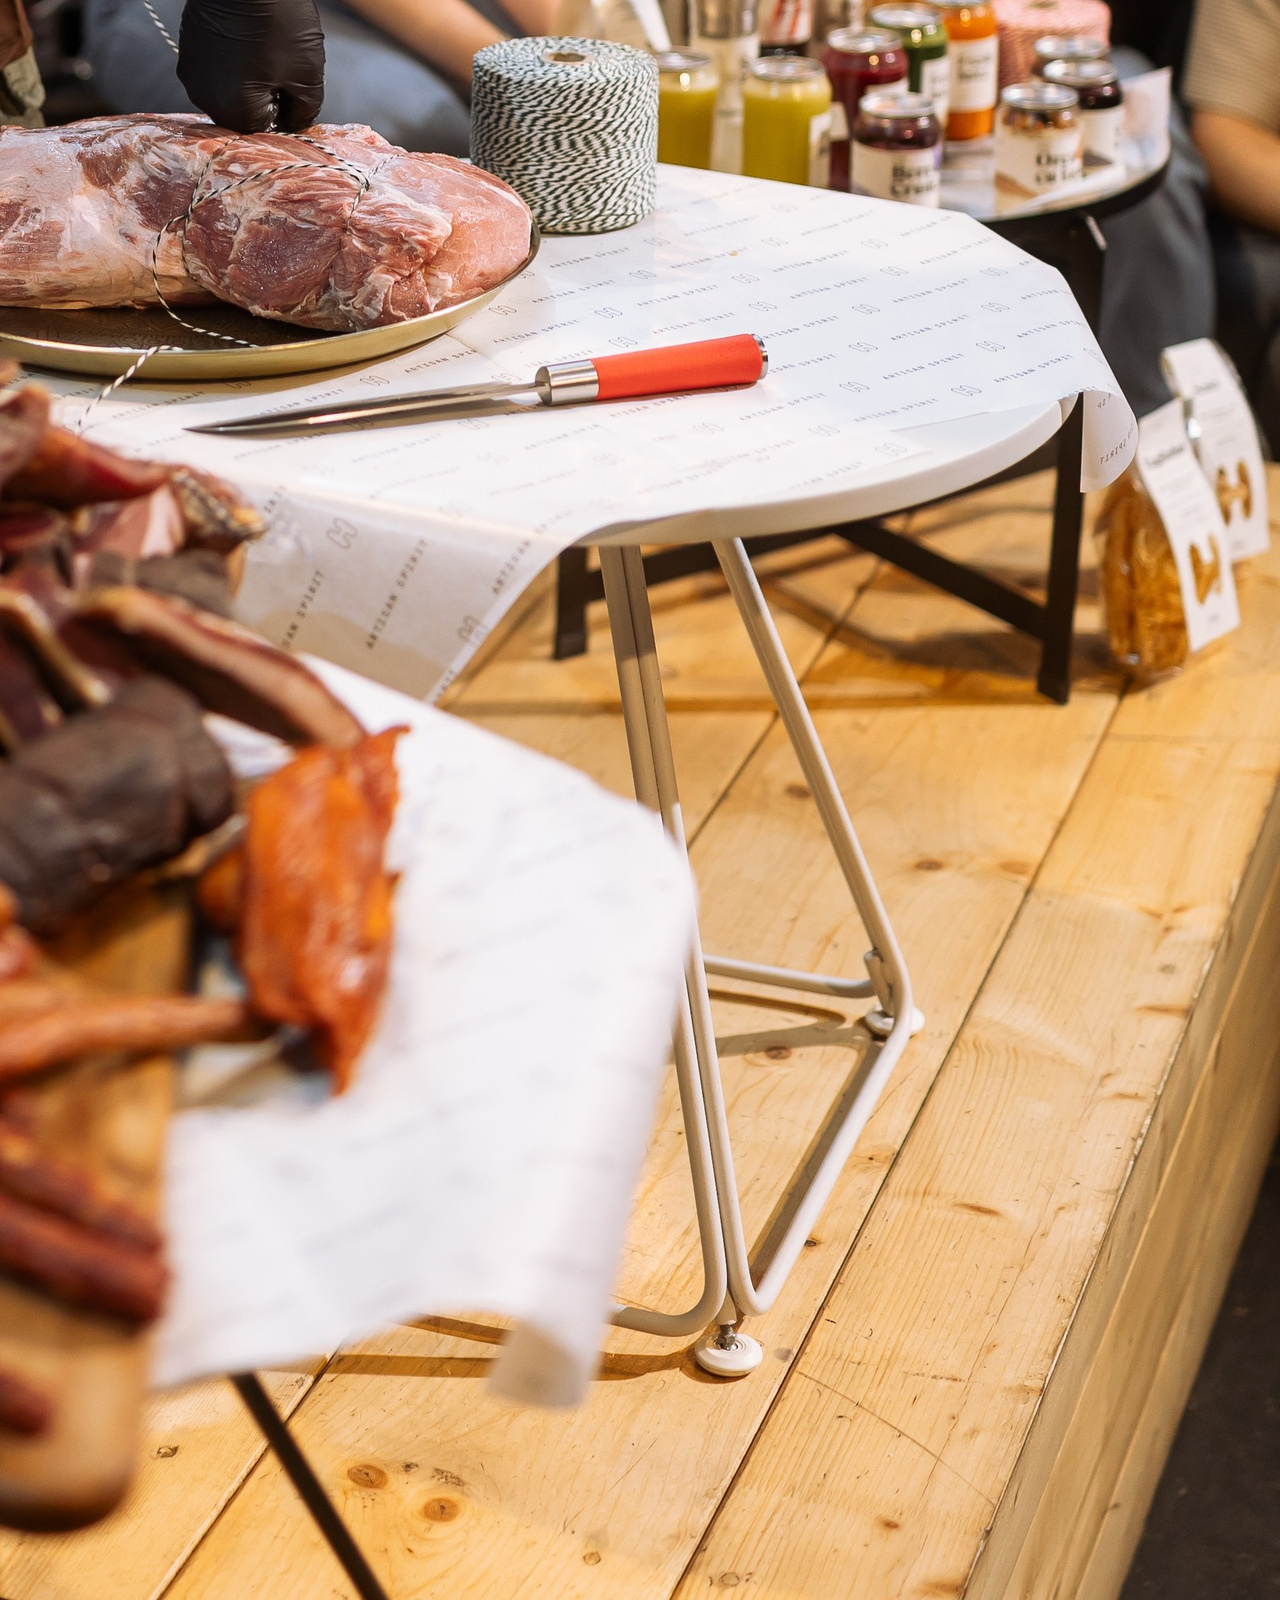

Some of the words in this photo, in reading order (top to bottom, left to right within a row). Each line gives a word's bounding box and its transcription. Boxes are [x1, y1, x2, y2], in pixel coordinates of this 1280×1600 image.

[670, 258, 712, 269] ARTISAN
[772, 261, 812, 273] ARTISAN
[815, 250, 848, 262] SPIRIT
[532, 290, 576, 304] ARTISAN
[578, 280, 615, 292] SPIRIT
[637, 295, 680, 306] ARTISAN
[682, 284, 719, 296] SPIRIT
[790, 287, 831, 300] ARTISAN
[833, 277, 868, 288] SPIRIT
[892, 290, 933, 303] ARTISAN
[934, 278, 969, 292] SPIRIT
[493, 332, 538, 344] ARTISAN
[541, 320, 579, 332] SPIRIT
[652, 322, 696, 334] ARTISAN
[699, 312, 735, 322] SPIRIT
[762, 327, 800, 339] RTISAN
[803, 315, 839, 328] SPIRIT
[890, 327, 932, 341] ARTISAN
[934, 314, 969, 328] SPIRIT
[1016, 324, 1057, 338] ARTISAN
[404, 358, 449, 374] ARTISAN
[452, 348, 479, 359] SPIR
[798, 354, 836, 366] SPIRIT
[882, 366, 926, 380] ARTISAN
[928, 353, 964, 366] SPIRIT
[994, 368, 1036, 383] ARTISAN
[1037, 354, 1073, 368] SPIRIT
[260, 401, 301, 416] RTISAN
[304, 388, 344, 402] SPIRIT
[609, 406, 650, 417] RTISAN
[739, 406, 784, 421] ARTISAN
[787, 392, 826, 406] SPIRIT
[854, 410, 898, 422] ARTISAN
[900, 398, 938, 411] SPIRIT
[296, 569, 324, 618] SPIRIT
[365, 593, 398, 650] ARTISAN
[396, 538, 427, 588] SPIRIT
